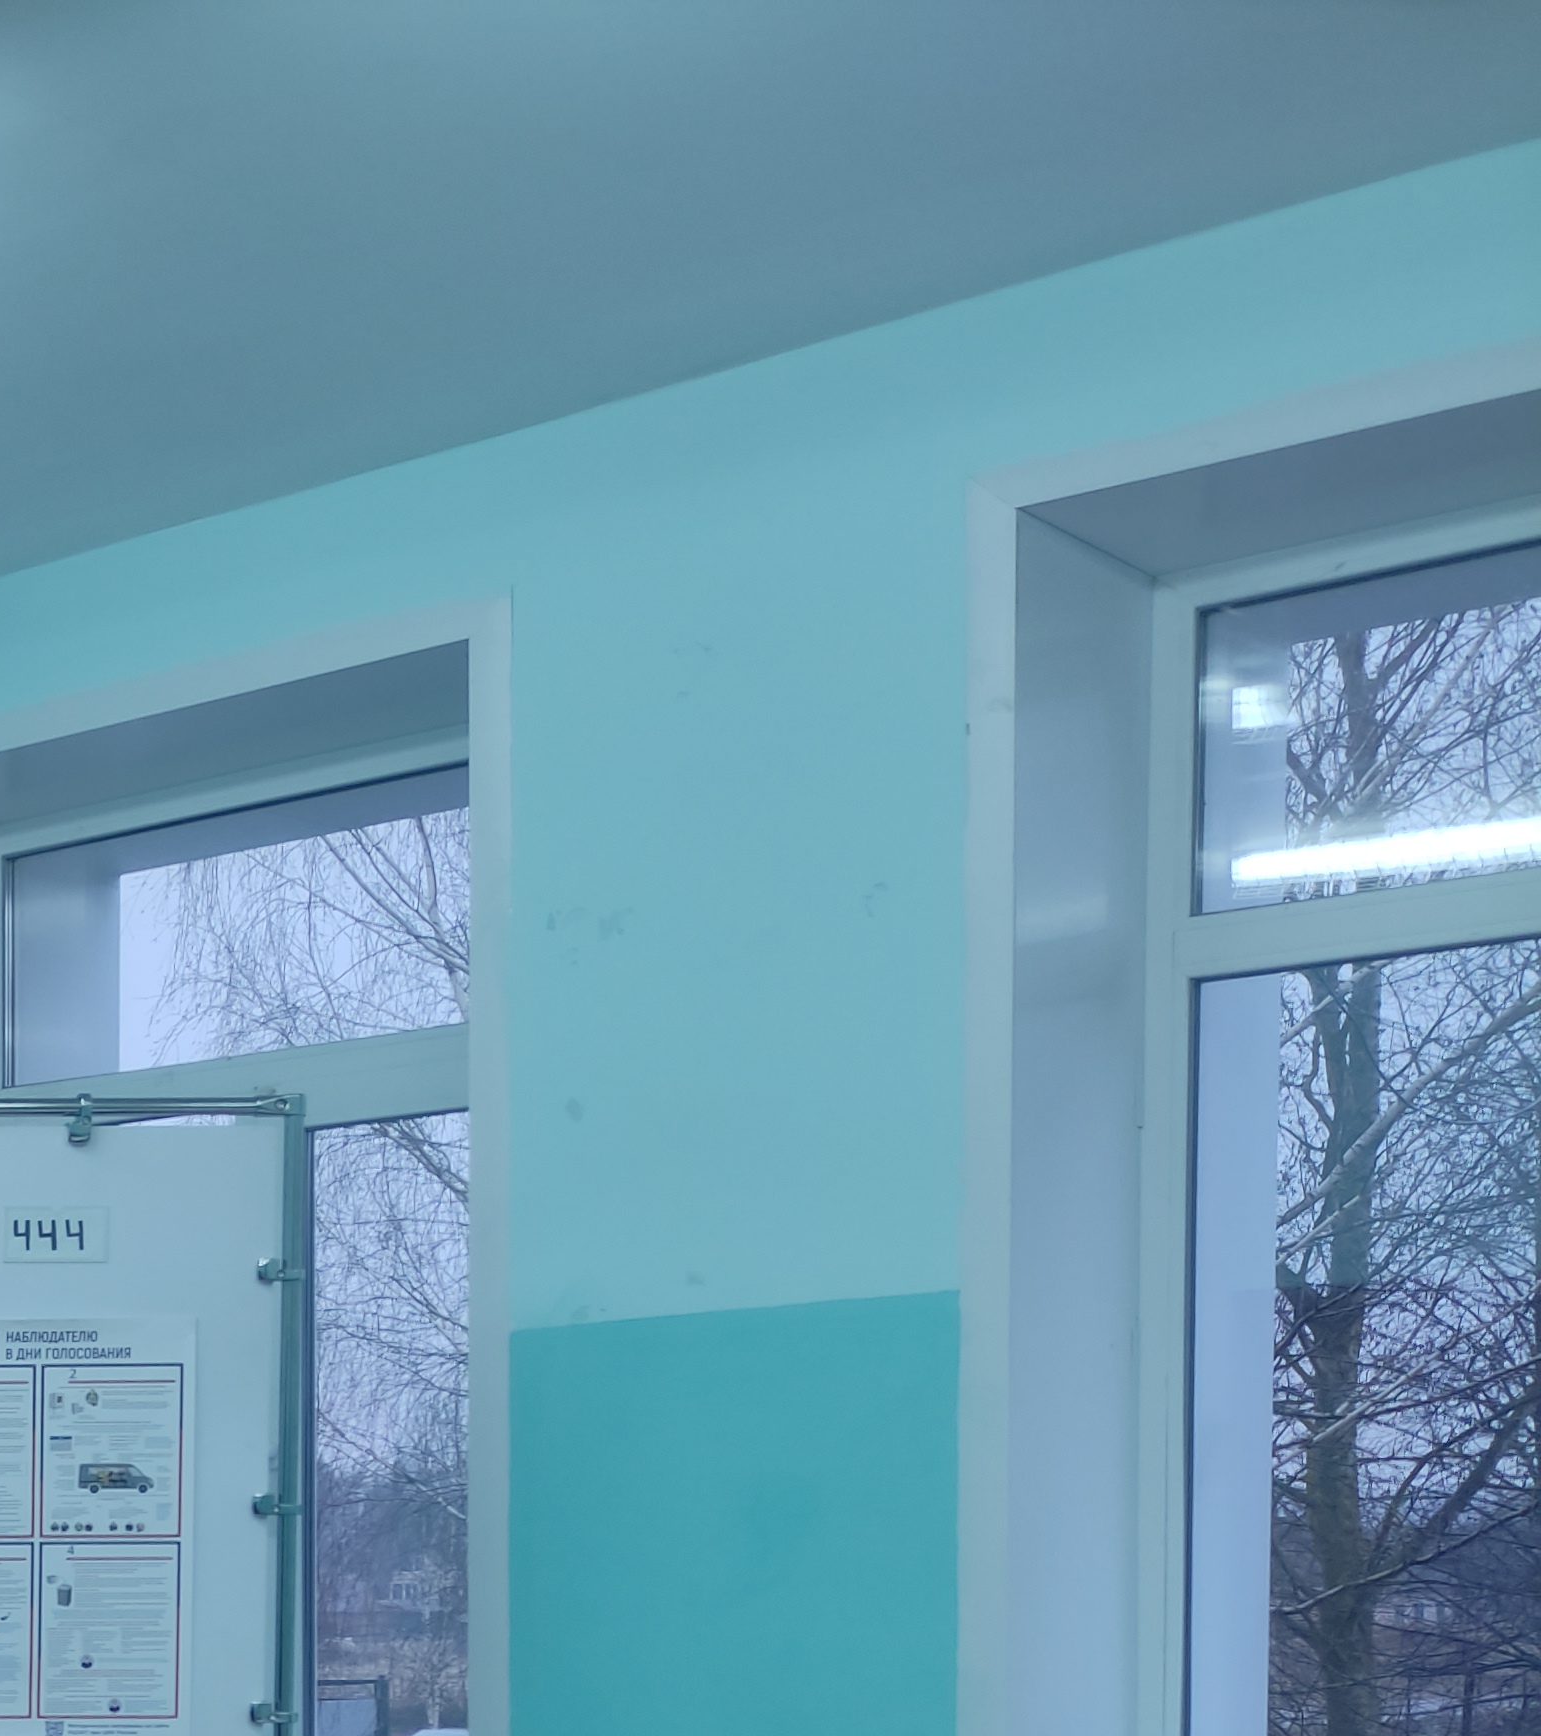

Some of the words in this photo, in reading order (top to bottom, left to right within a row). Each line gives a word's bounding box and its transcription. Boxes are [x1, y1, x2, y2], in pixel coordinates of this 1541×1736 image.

[6, 1330, 98, 1343] НАБЛЮДАТЕЛЮ
[5, 1348, 13, 1360] В
[16, 1347, 42, 1361] ДНИ
[45, 1347, 132, 1360] ГОЛОСОВАНИЯ
[69, 1368, 77, 1379] 2
[67, 1546, 75, 1556] 4
